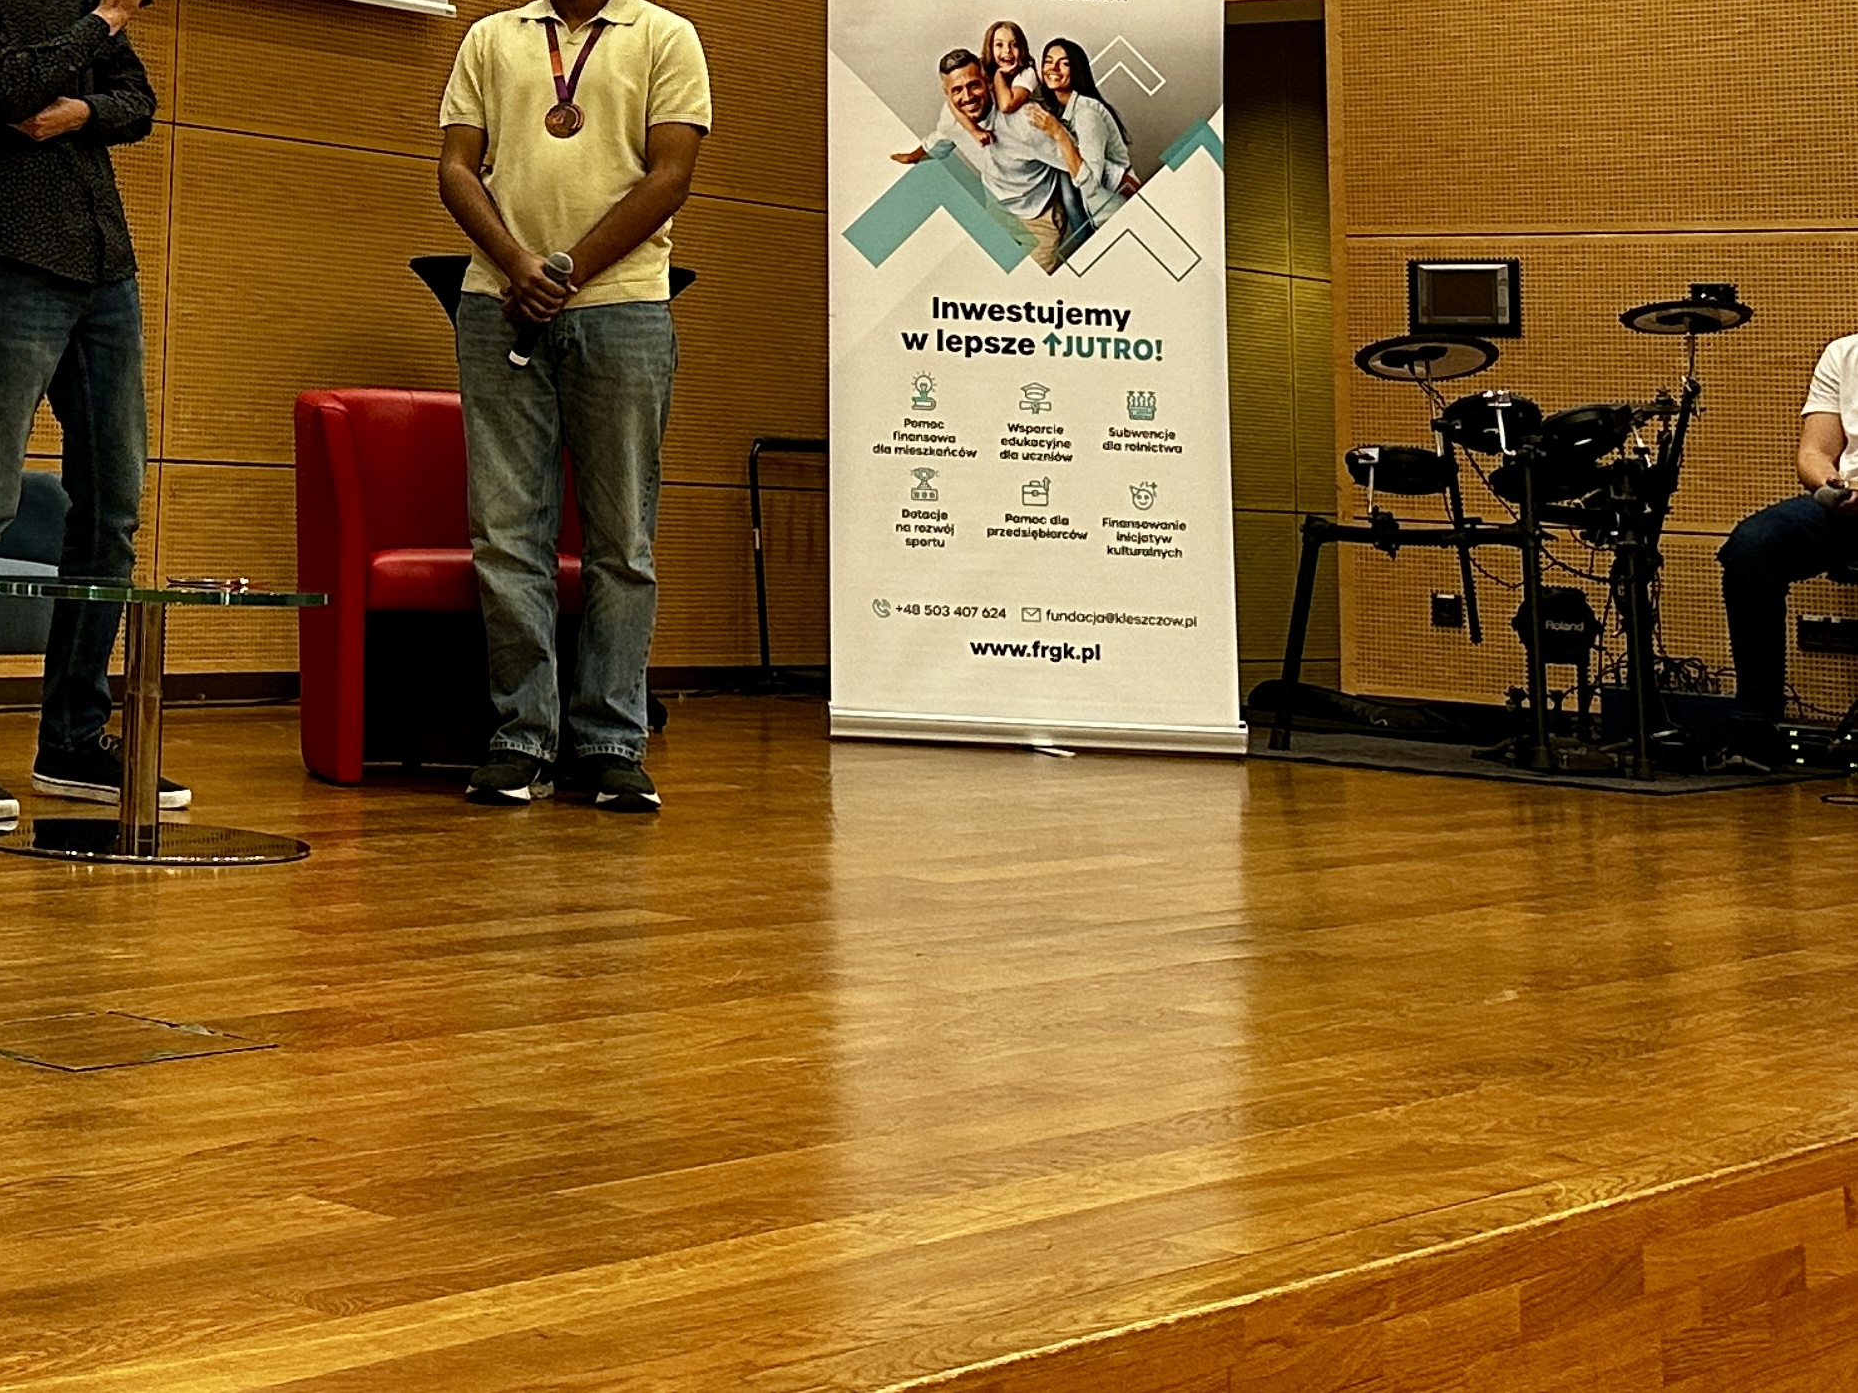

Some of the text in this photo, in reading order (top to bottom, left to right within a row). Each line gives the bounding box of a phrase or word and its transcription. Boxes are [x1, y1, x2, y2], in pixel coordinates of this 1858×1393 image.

[932, 296, 1131, 332] Inwestujemy
[901, 329, 1163, 362] w lepsze JUTRO!
[904, 418, 945, 430] Pomoc
[1007, 423, 1064, 436] Wsparcie
[893, 431, 956, 444] finansowa
[1108, 427, 1176, 441] Subwencje
[1000, 437, 1072, 450] edukacyjne
[1102, 441, 1183, 455] dla rolnictwa
[873, 444, 978, 458] dla mieszkańców
[999, 450, 1073, 463] dla uczniów
[902, 508, 948, 522] Dotacje
[1005, 513, 1069, 526] Pomoc dla
[895, 523, 955, 537] na rozwój
[1102, 517, 1187, 532] Finansowanie
[987, 527, 1088, 541] przedsiębiorców
[1116, 531, 1173, 545] inicjatyw
[905, 537, 945, 549] sportu
[1107, 545, 1183, 560] kulturalnych
[896, 604, 1006, 619] +48 503 407 624
[1046, 609, 1198, 629] fundacja@kleszczow.pl
[1545, 619, 1585, 632] Roland
[970, 640, 1101, 664] www.frgk.pl
